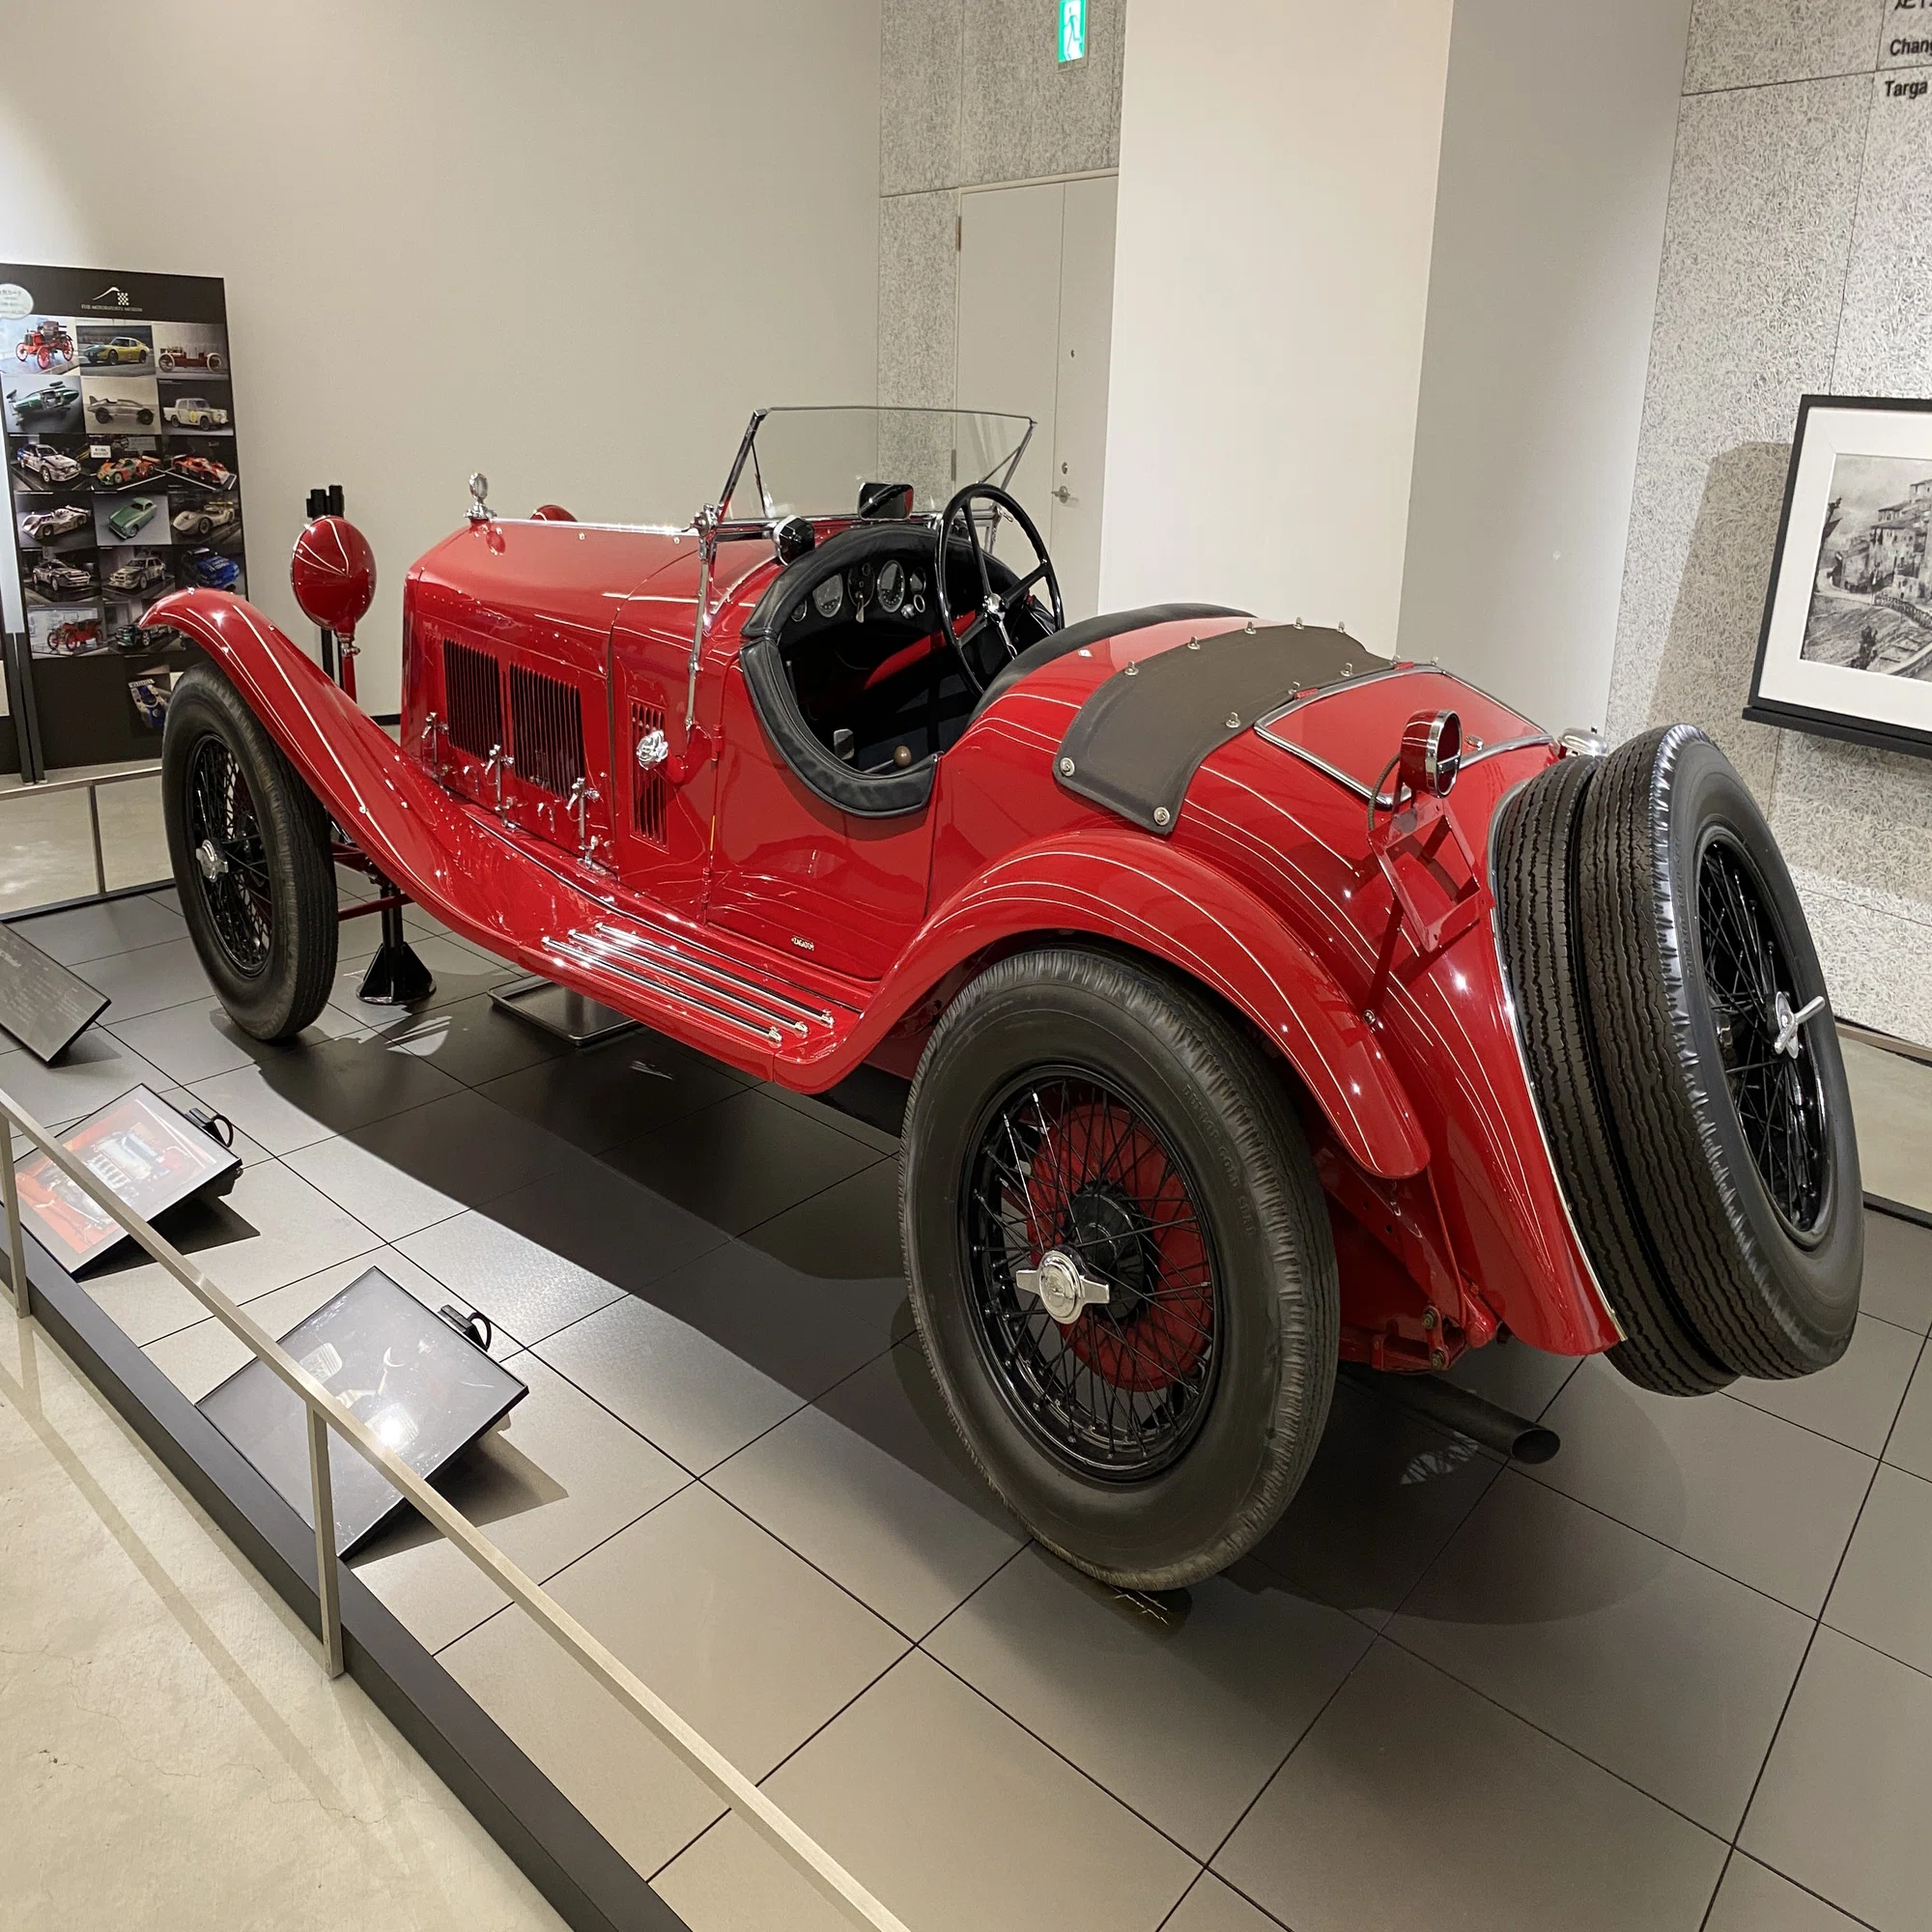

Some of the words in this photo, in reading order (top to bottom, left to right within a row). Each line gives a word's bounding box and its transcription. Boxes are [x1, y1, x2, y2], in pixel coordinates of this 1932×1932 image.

[1889, 39, 1932, 56] Chan
[1885, 80, 1928, 99] Targa
[1182, 1084, 1220, 1139] DUNLOP
[1218, 1146, 1240, 1187] GOLD
